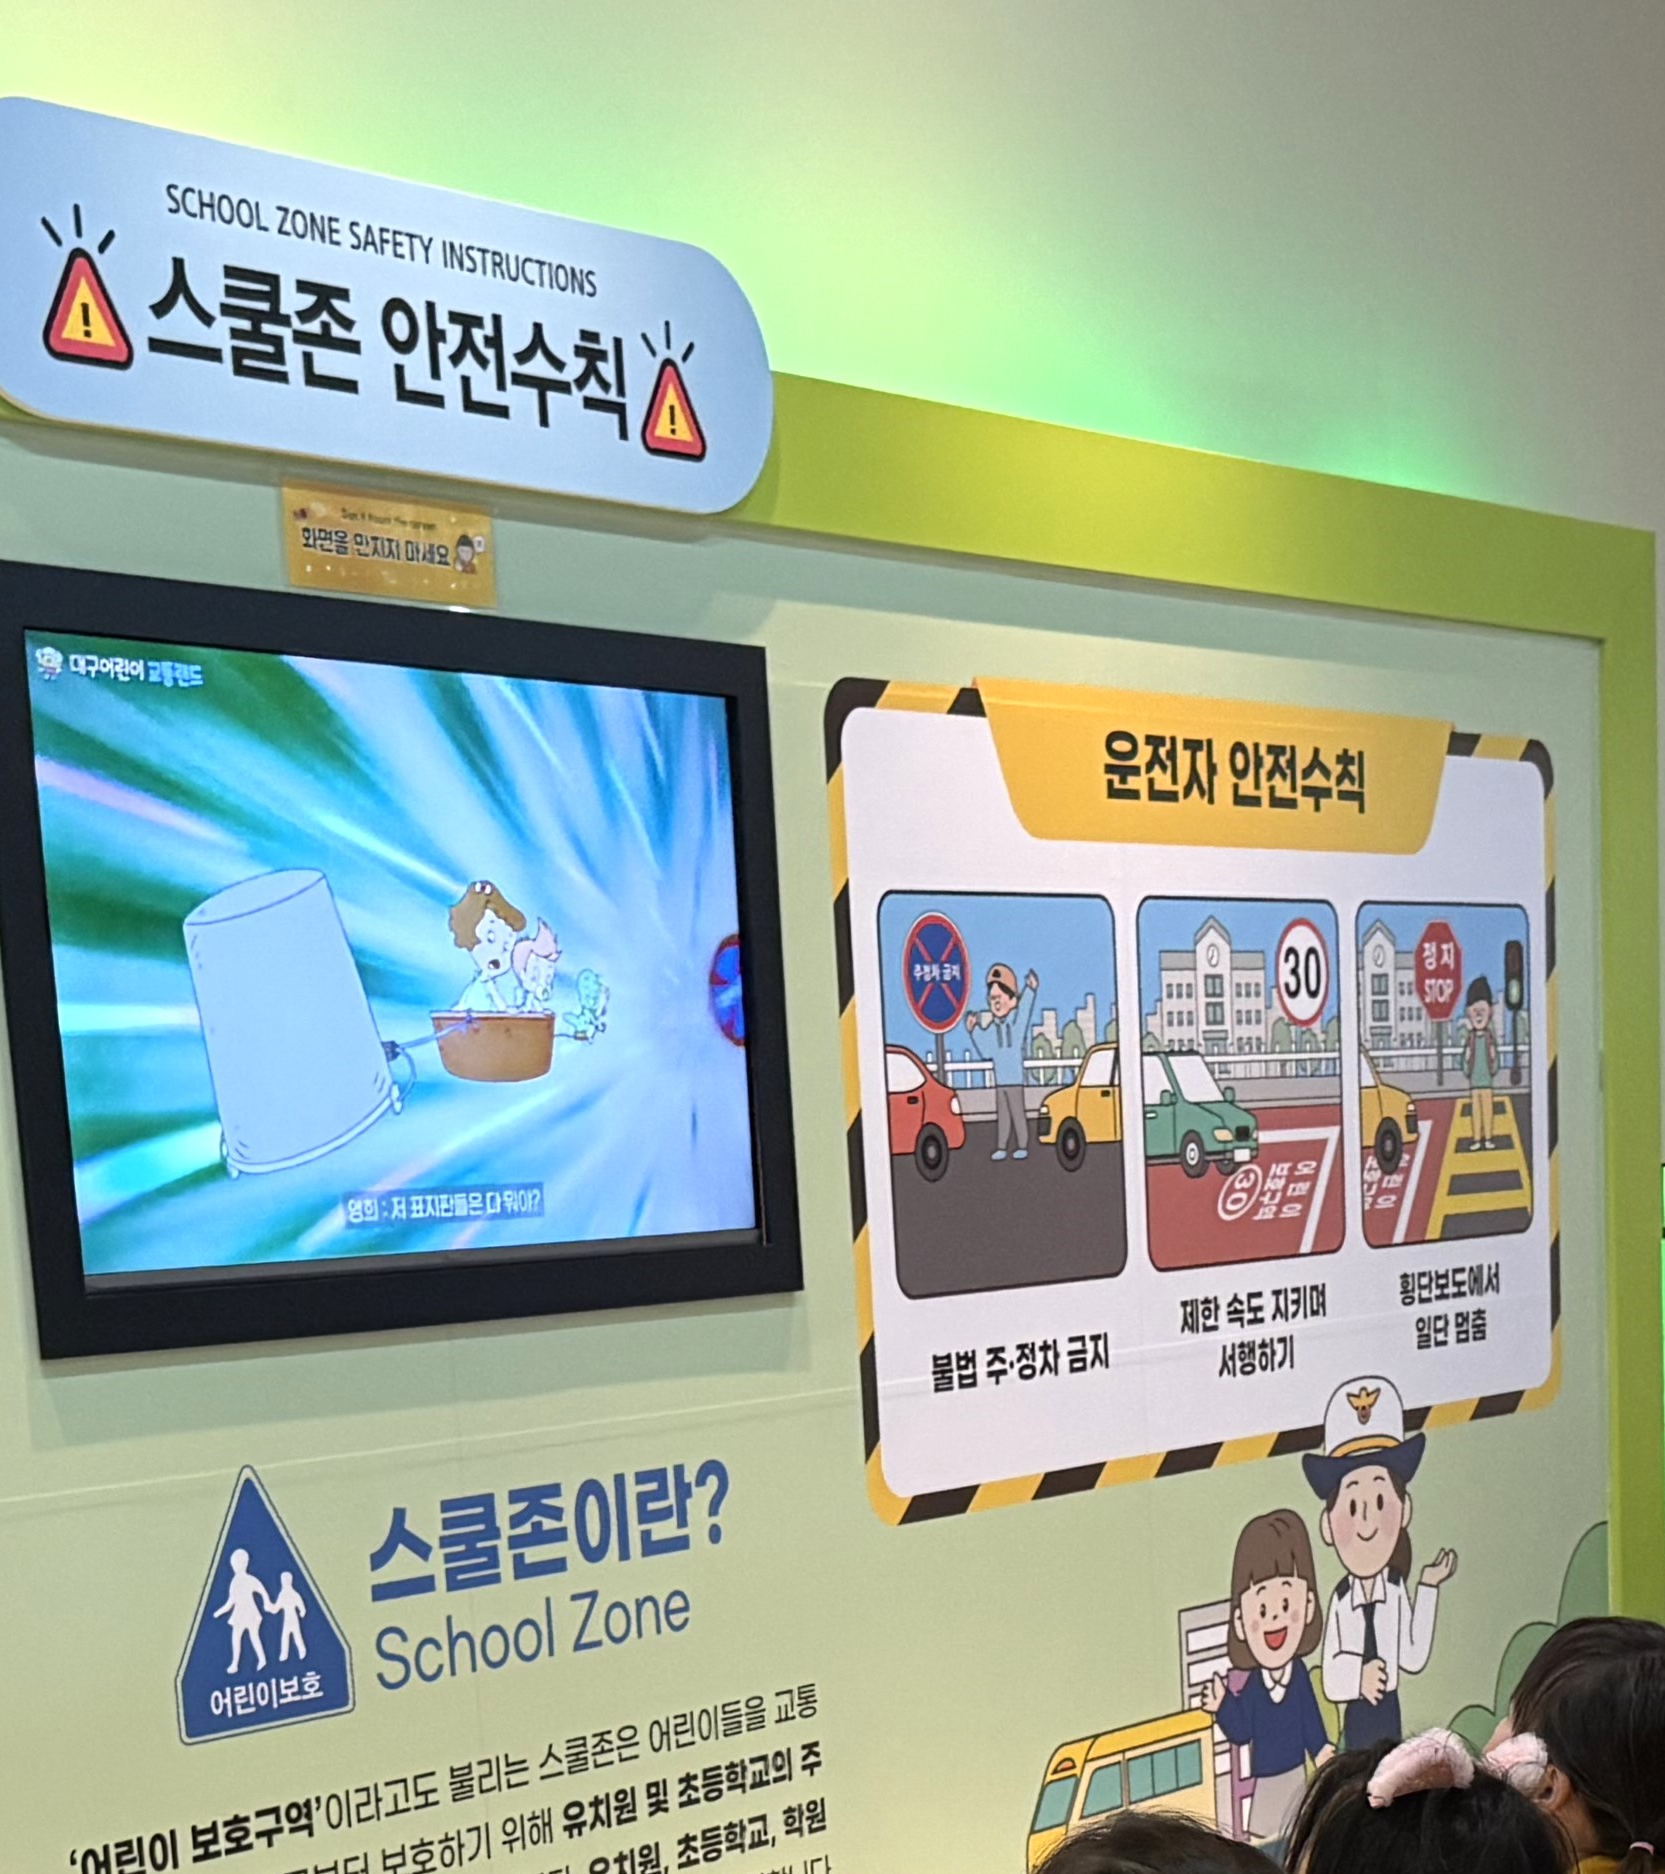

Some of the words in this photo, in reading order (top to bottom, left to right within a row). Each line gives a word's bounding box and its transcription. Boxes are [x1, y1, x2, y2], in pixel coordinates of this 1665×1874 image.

[166, 184, 269, 232] SCHOOL
[277, 206, 341, 246] ZONE
[349, 221, 433, 263] SAFETY
[442, 240, 597, 297] INSTRUCTIONS
[148, 256, 362, 395] 스쿨존
[381, 297, 629, 441] 안전수칙
[302, 527, 349, 555] 화면을
[353, 533, 400, 560] 만지지
[405, 540, 450, 566] 마세요
[69, 654, 145, 682] 대구어린이
[1104, 730, 1218, 805] 운전자
[1229, 741, 1365, 814] 안전수칙
[1284, 946, 1321, 999] 30
[1424, 979, 1454, 1003] STOP
[1179, 1294, 1220, 1334] 제한
[1225, 1290, 1264, 1328] 속도
[1271, 1282, 1327, 1323] 지키며
[1399, 1262, 1500, 1307] 횡단보도에서
[1219, 1336, 1294, 1379] 서행하기
[1415, 1315, 1448, 1351] 일단
[1454, 1309, 1487, 1344] 멈춤
[931, 1350, 977, 1393] 불법
[1067, 1332, 1110, 1372] 금지
[370, 1459, 729, 1602] 스쿨존이란?
[376, 1596, 555, 1690] School
[570, 1589, 691, 1653] Zone
[210, 1671, 323, 1718] 어린이보호
[449, 1753, 529, 1802] 불리는
[539, 1725, 639, 1780] 스쿨존은
[649, 1695, 766, 1753] 어린이들을
[774, 1683, 818, 1724] 교통
[502, 1806, 553, 1854] 위해
[563, 1786, 637, 1839] 유치원
[645, 1778, 669, 1817] 및
[677, 1747, 793, 1809] 초등학교의
[801, 1740, 822, 1777] 주
[677, 1813, 775, 1870] 초등학교,
[782, 1797, 827, 1838] 학원
